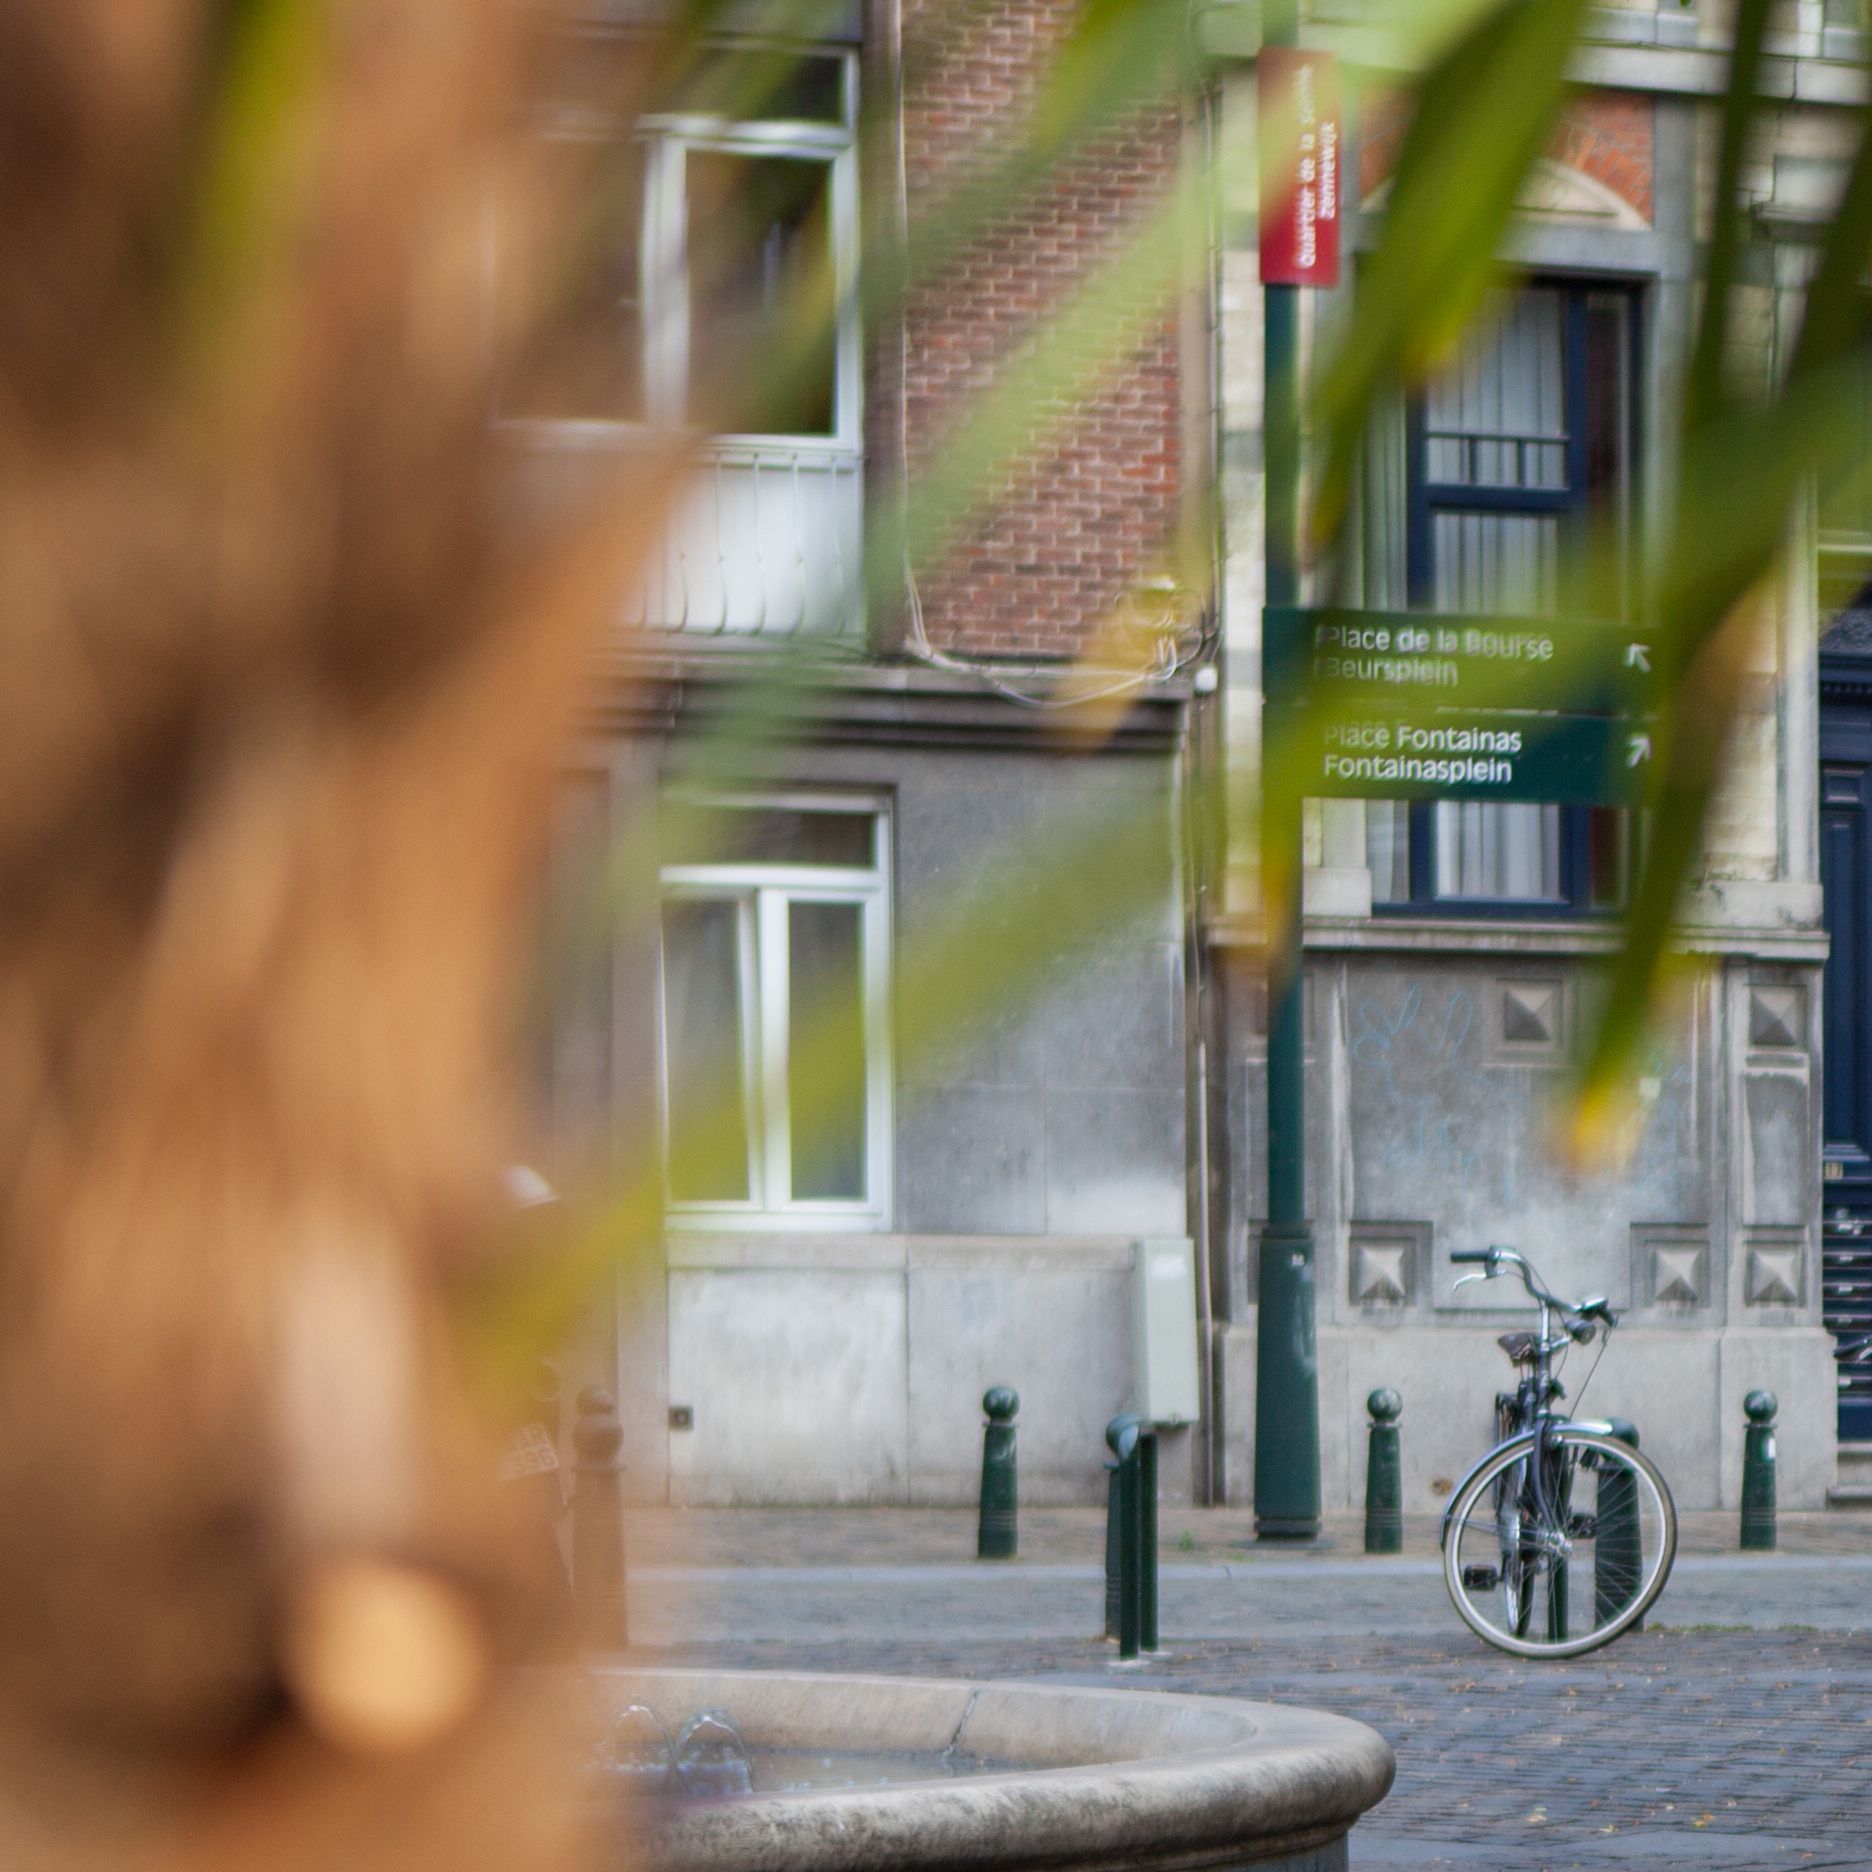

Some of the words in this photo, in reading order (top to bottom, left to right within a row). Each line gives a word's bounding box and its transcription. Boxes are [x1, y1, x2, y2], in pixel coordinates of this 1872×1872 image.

[1299, 156, 1315, 182] de
[1315, 626, 1391, 650] Place
[1397, 627, 1431, 653] de
[1437, 629, 1458, 653] la
[1465, 628, 1554, 660] Bourse
[1315, 656, 1458, 686] Beursplein
[1324, 722, 1391, 748] Place
[1397, 727, 1522, 754] Fontainas
[1323, 754, 1512, 786] Fontainasplein
